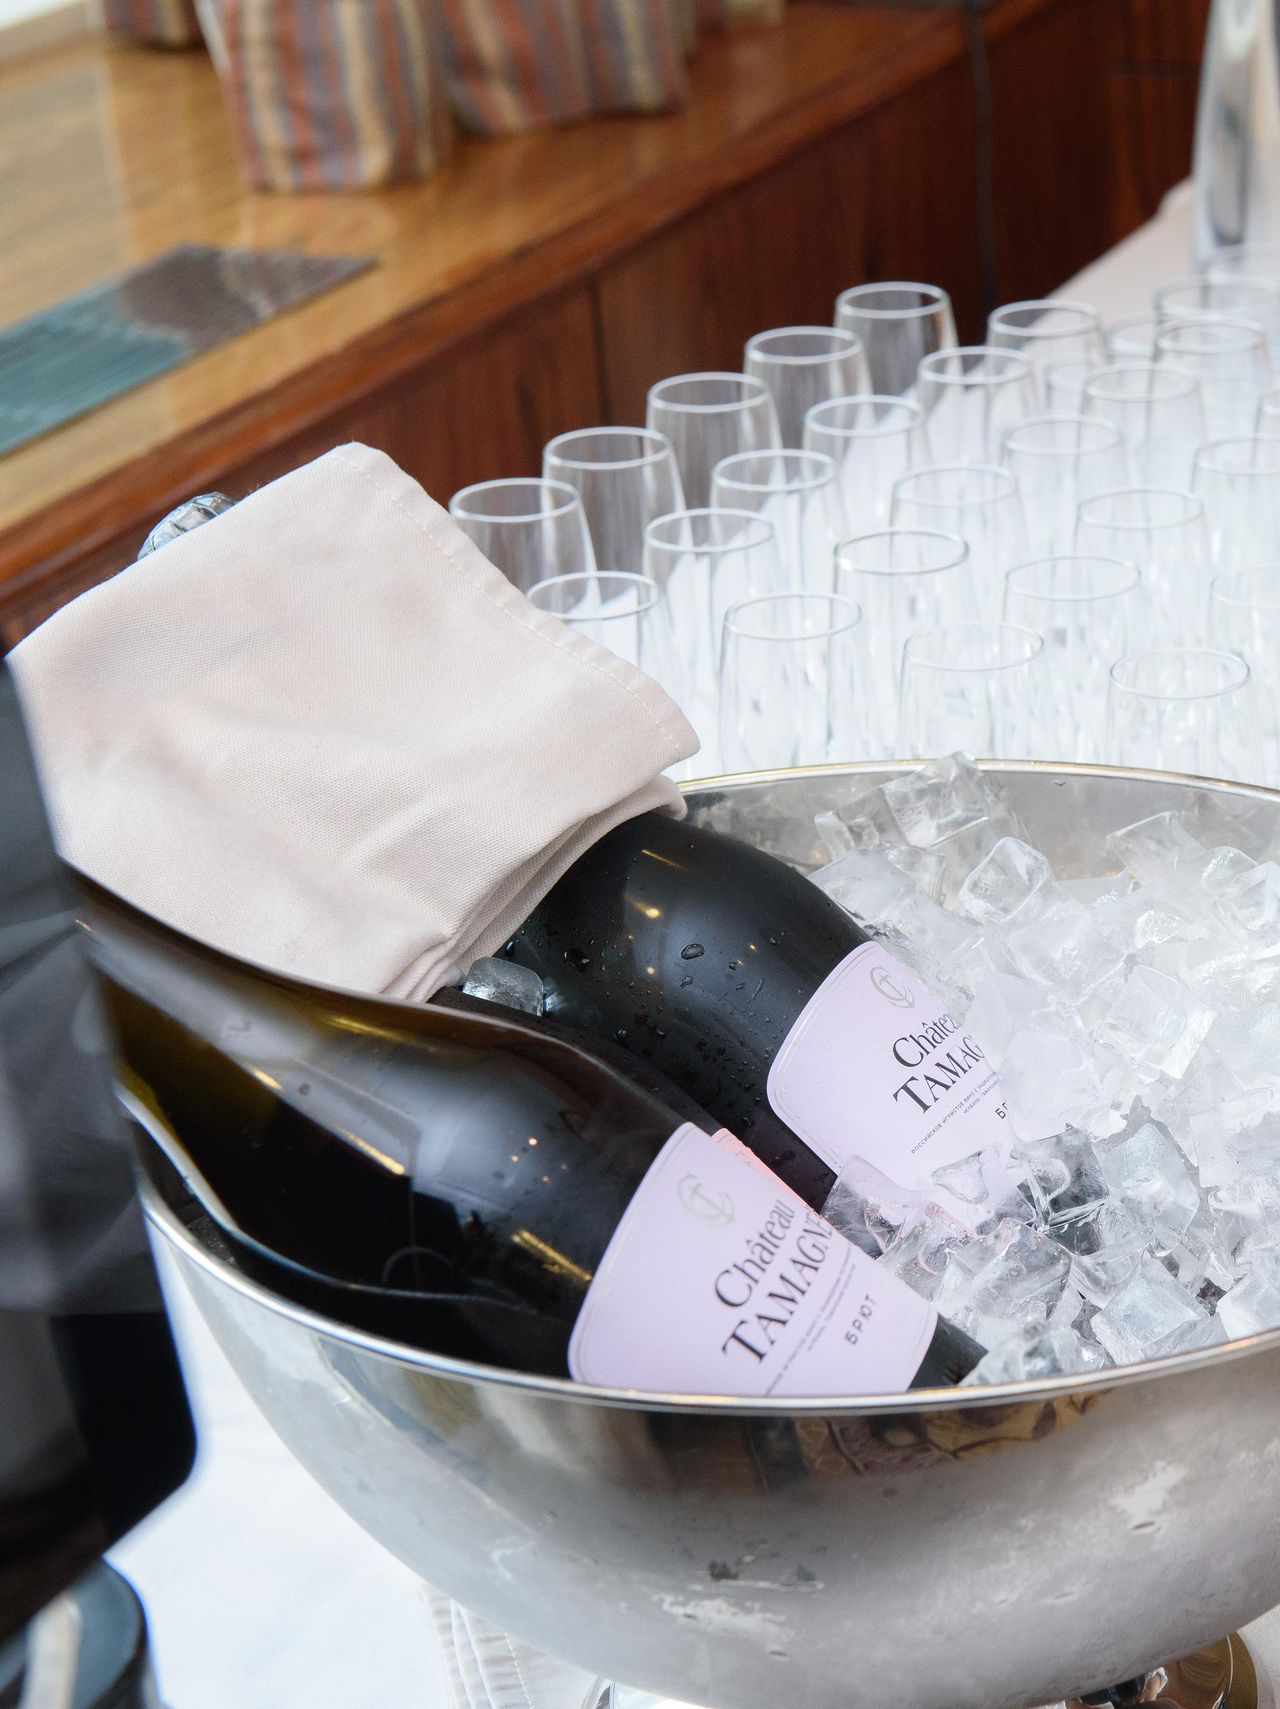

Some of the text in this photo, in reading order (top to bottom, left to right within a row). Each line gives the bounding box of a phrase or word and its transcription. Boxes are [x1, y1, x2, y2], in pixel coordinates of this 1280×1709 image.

[893, 1013, 963, 1067] Châtea
[893, 1035, 985, 1114] TAMAG
[714, 1199, 795, 1308] Château
[844, 1294, 877, 1346] БРЮТ
